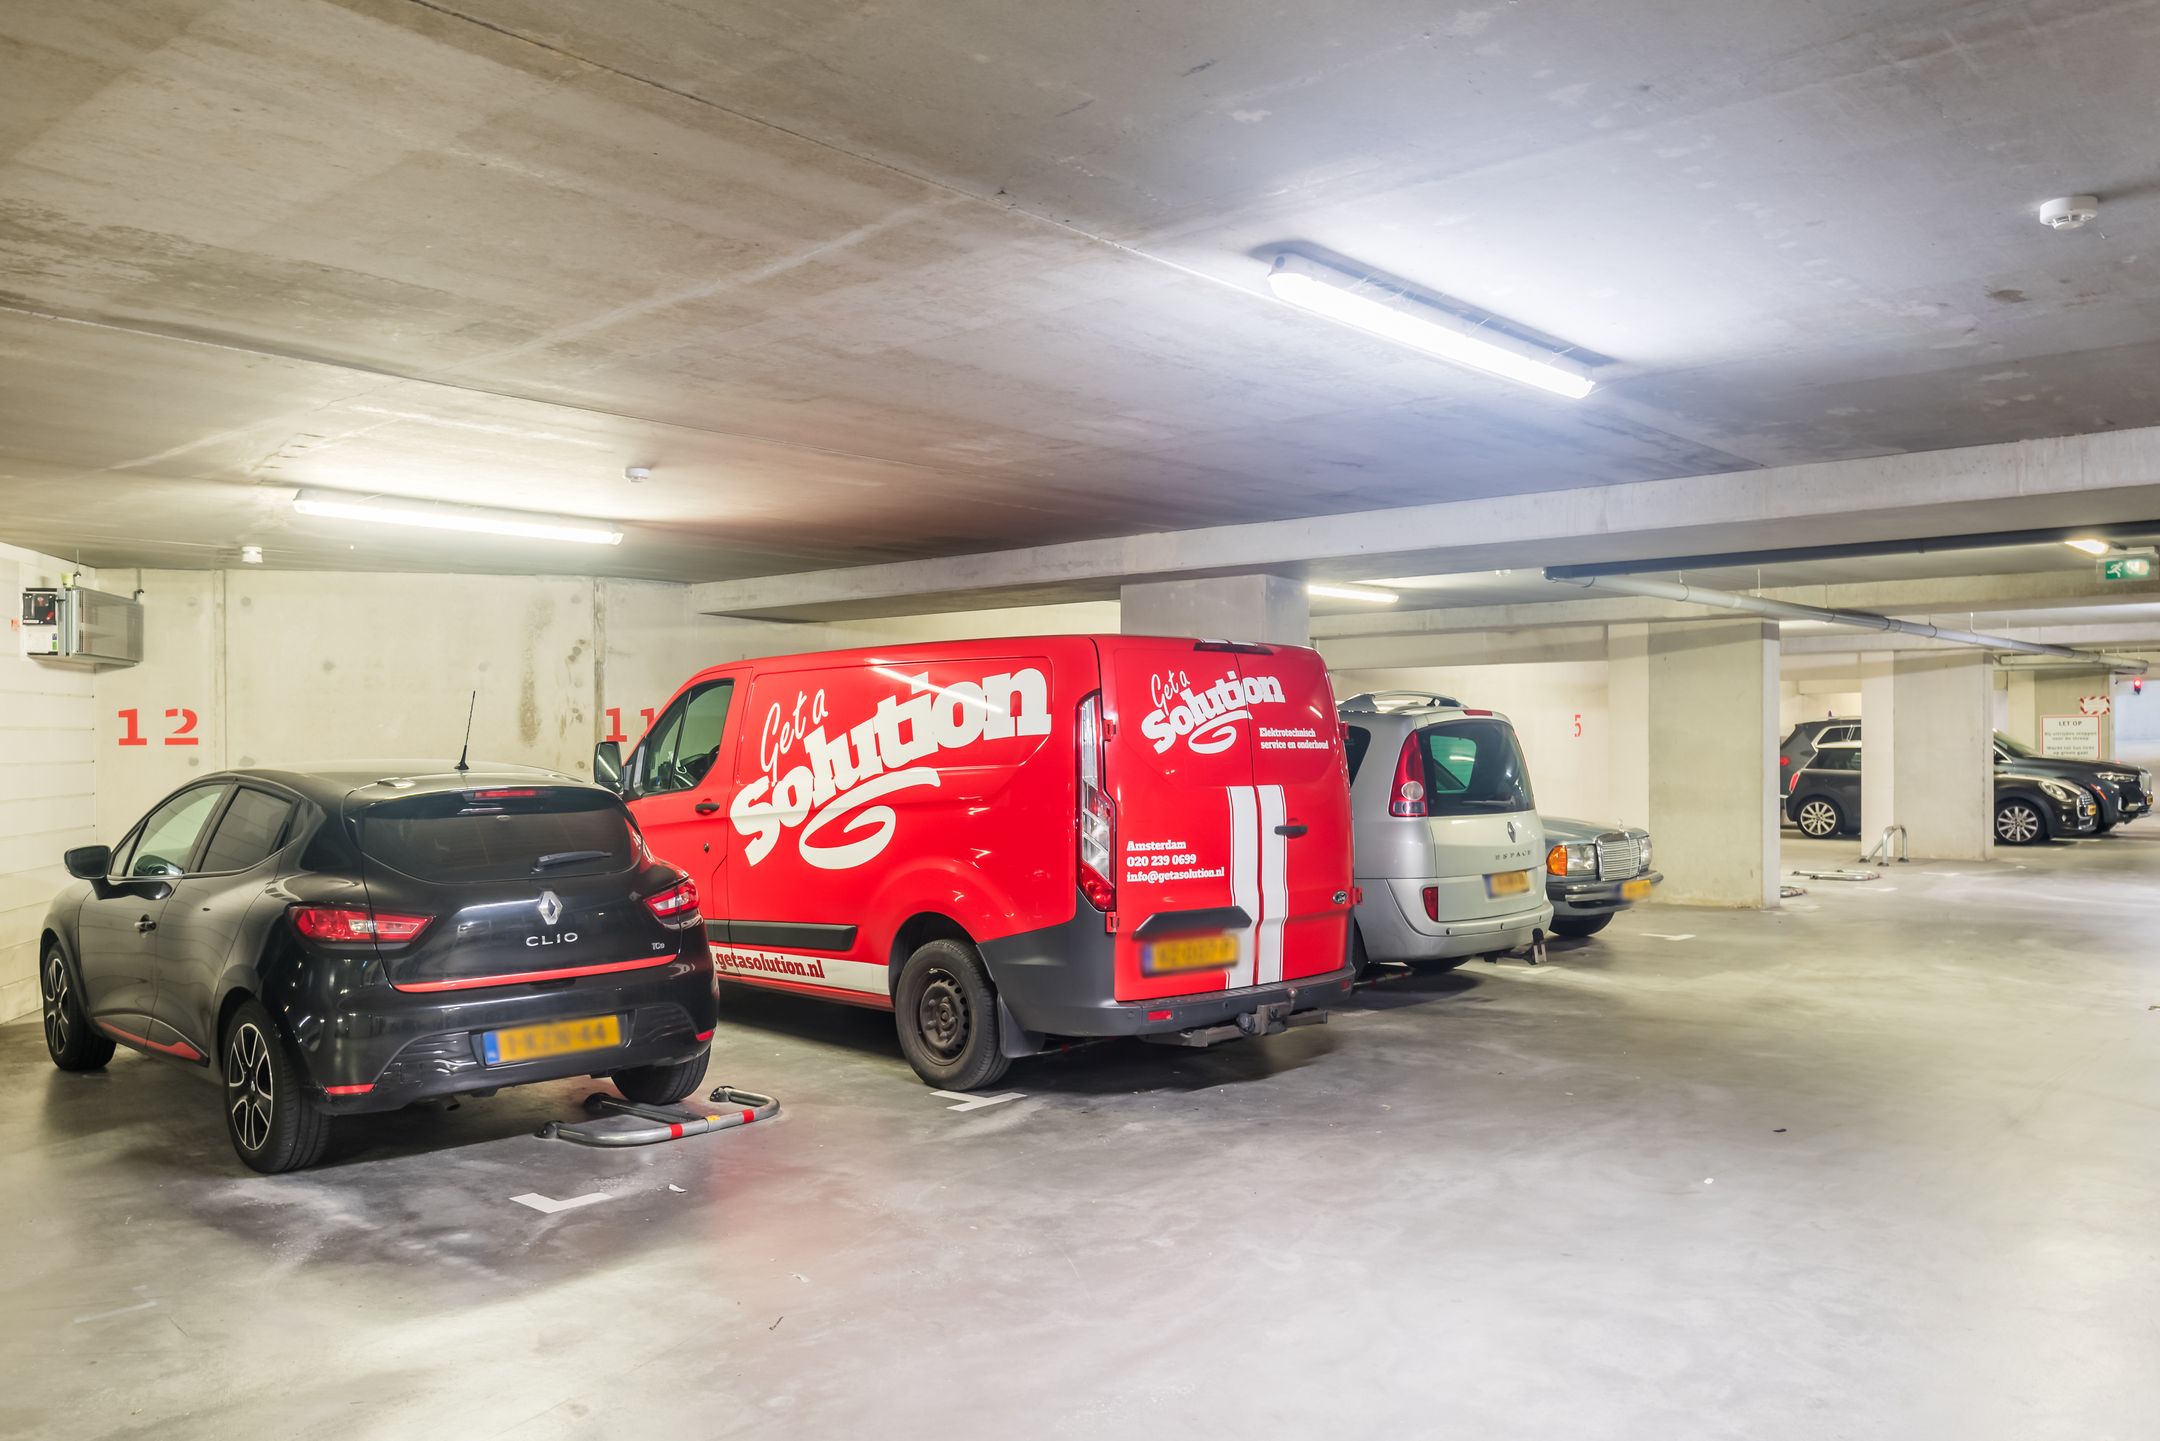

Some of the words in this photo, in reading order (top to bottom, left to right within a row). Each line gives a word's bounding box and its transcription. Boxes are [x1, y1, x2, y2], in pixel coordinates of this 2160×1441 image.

[1151, 670, 1179, 716] Get
[1179, 670, 1191, 688] a
[117, 708, 199, 746] 12
[1574, 713, 1582, 737] 5
[760, 690, 807, 784] Get
[812, 688, 829, 725] a
[1260, 739, 1286, 750] service
[1287, 741, 1297, 749] en
[1126, 839, 1187, 852] Amsterdam
[1126, 856, 1149, 867] 020
[1150, 855, 1170, 867] 239
[1171, 853, 1197, 866] 0699
[1495, 850, 1531, 861] ESPACE
[1126, 866, 1225, 884] info@getasolution.nl
[525, 932, 579, 947] CLIO
